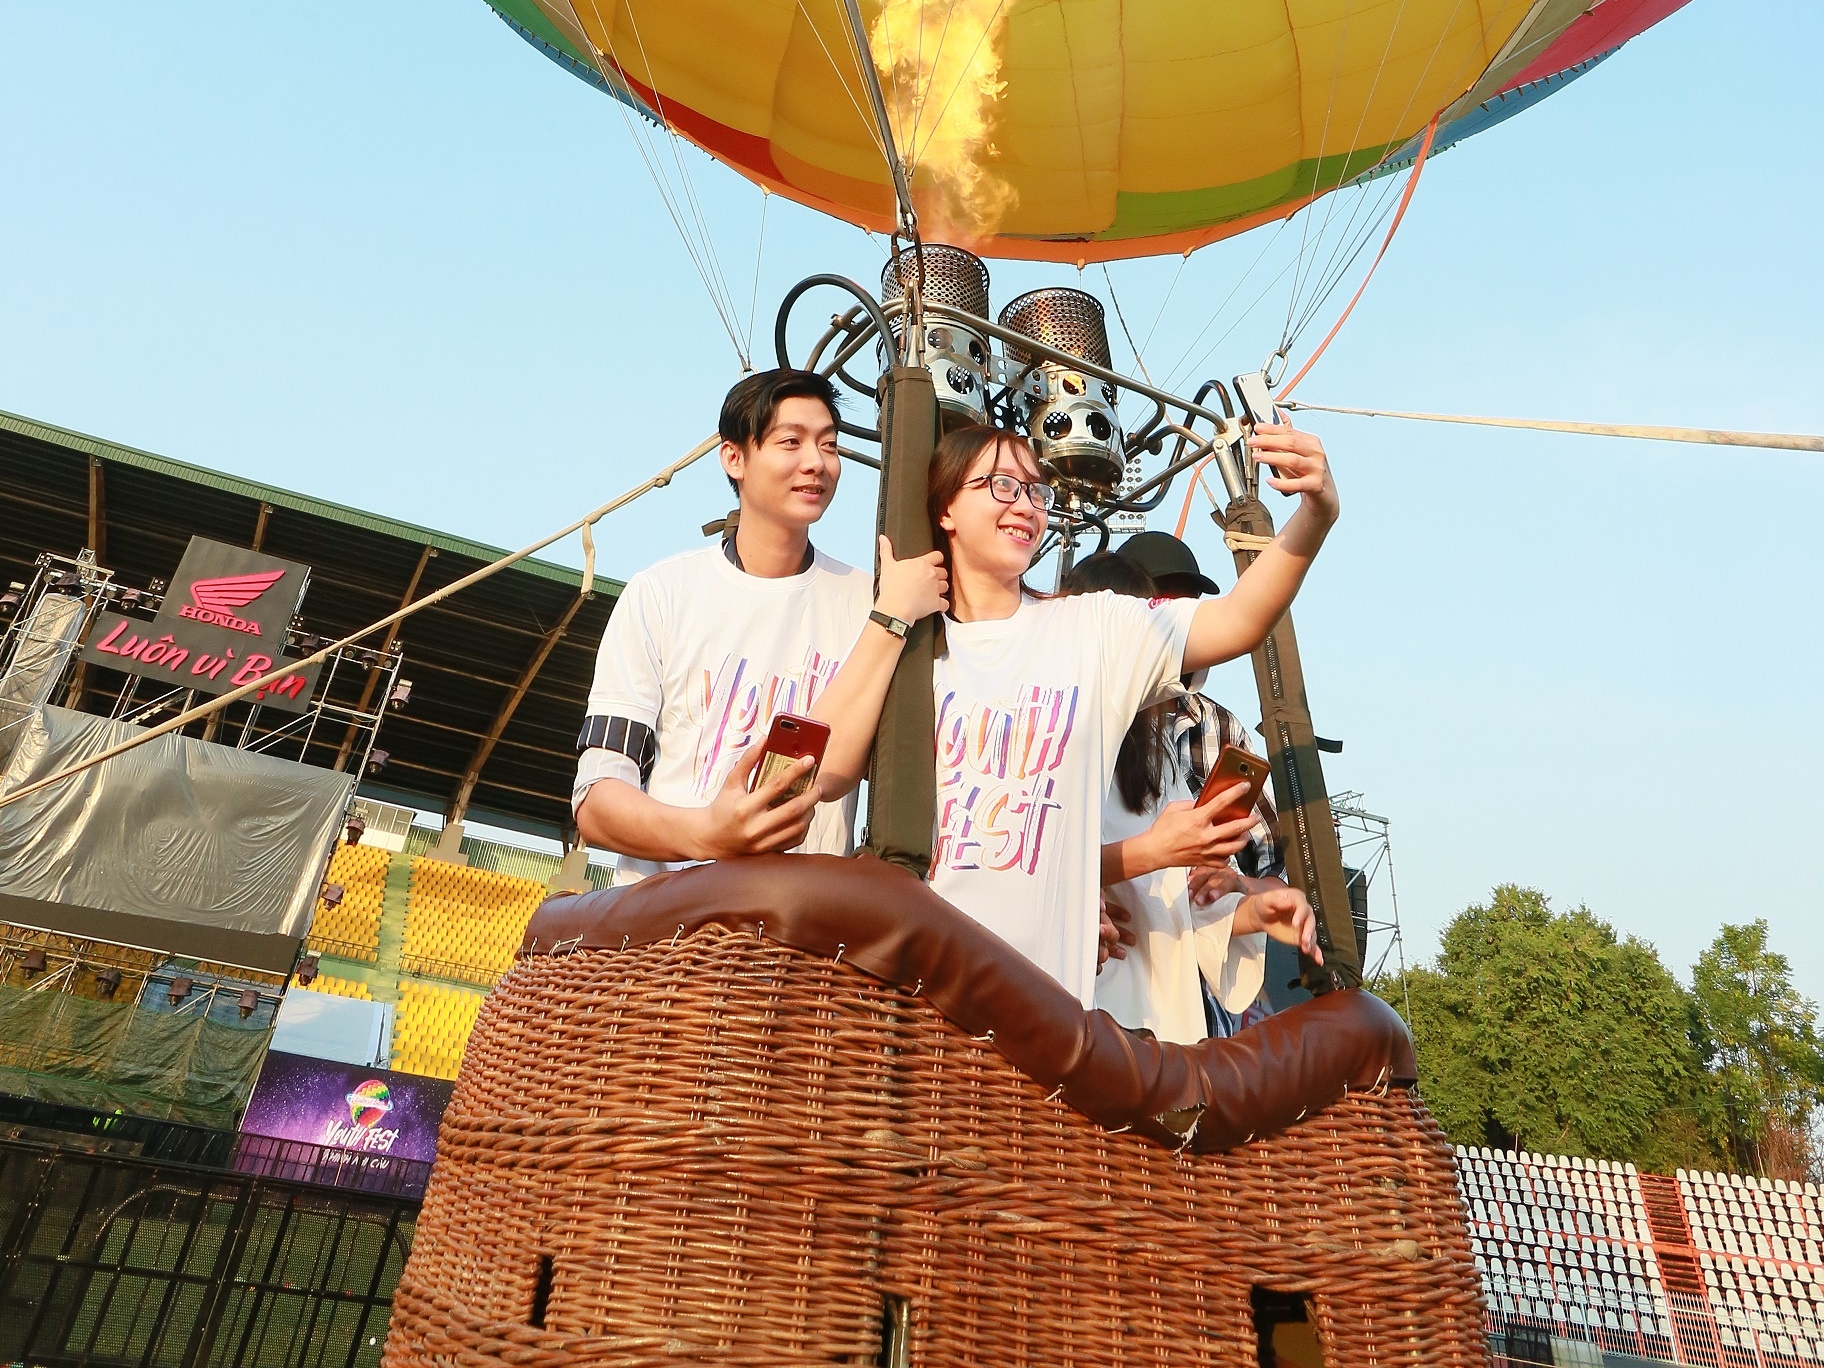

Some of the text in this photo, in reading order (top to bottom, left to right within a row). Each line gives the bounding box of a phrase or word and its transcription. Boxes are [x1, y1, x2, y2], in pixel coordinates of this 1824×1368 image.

[179, 605, 262, 636] HONDA
[96, 620, 189, 671] Luôn
[191, 648, 235, 680] vì
